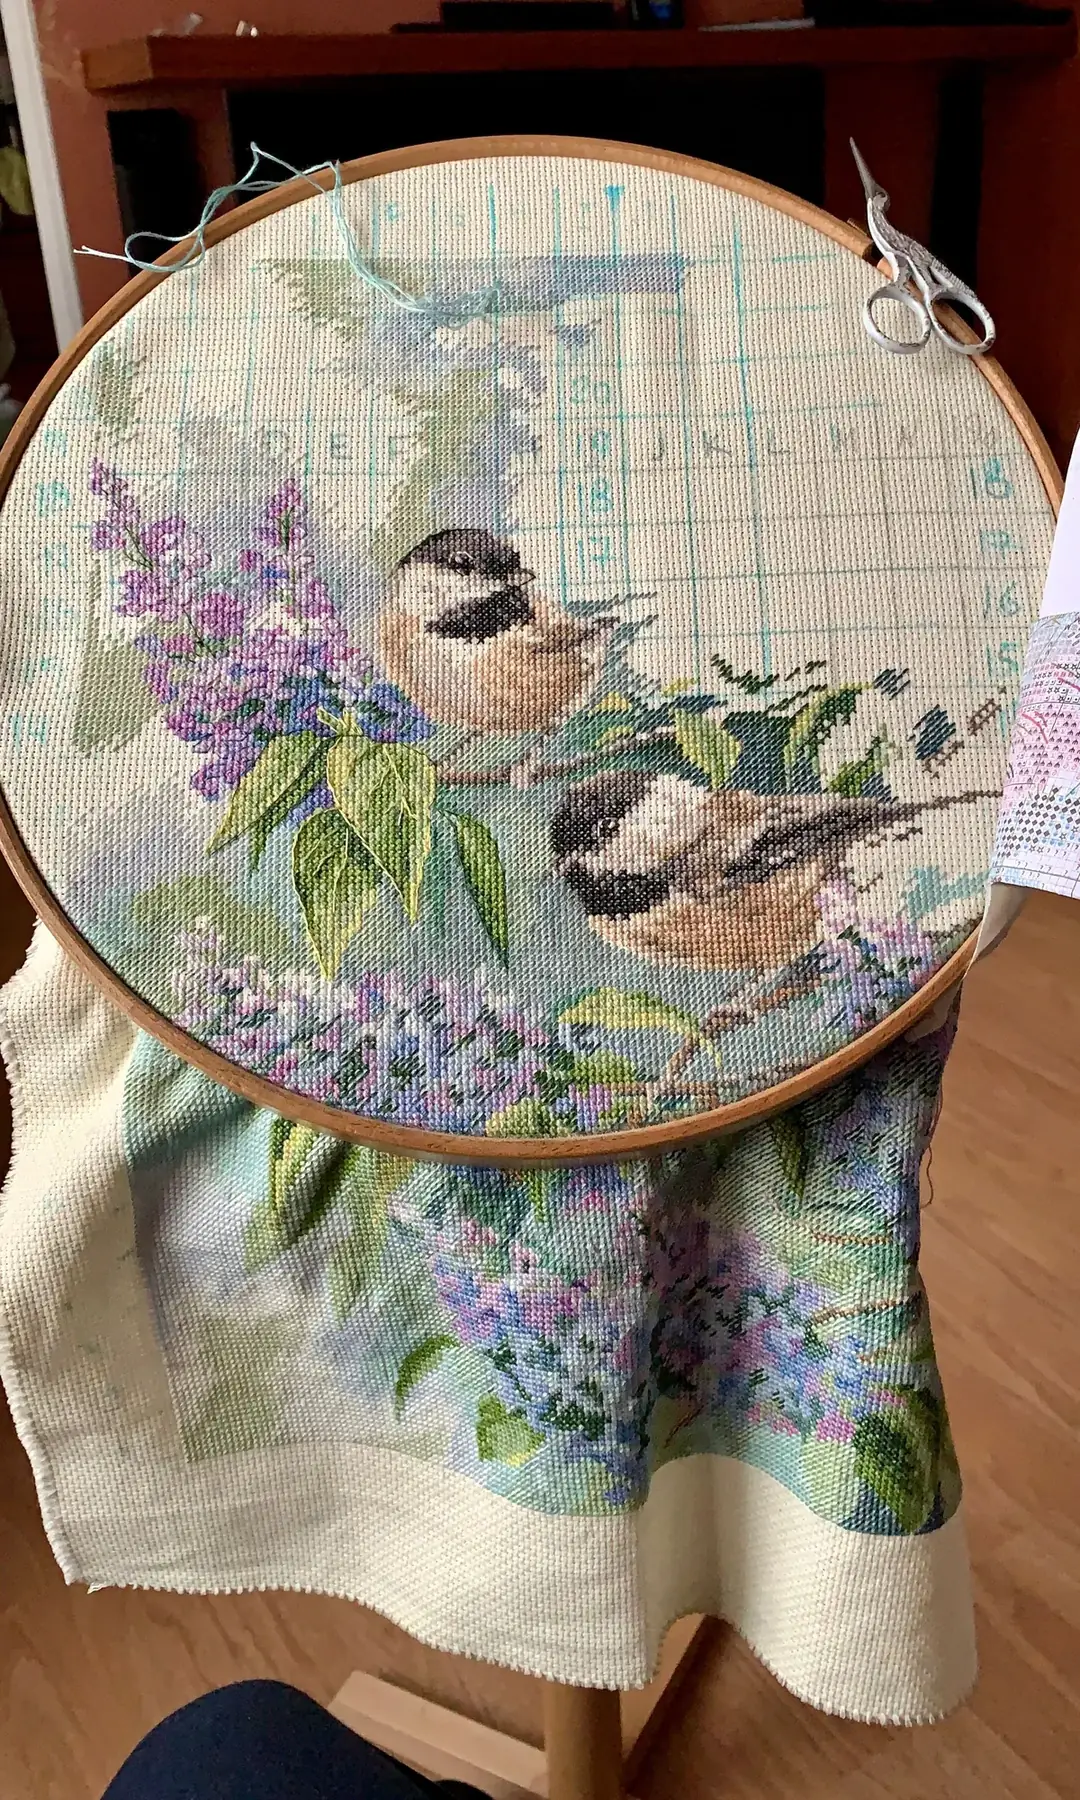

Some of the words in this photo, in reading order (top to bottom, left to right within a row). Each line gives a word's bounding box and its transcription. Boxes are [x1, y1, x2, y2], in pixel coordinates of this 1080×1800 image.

[329, 433, 352, 461] E
[650, 429, 667, 463] J
[702, 429, 733, 458] K
[983, 579, 1021, 619] 16
[985, 640, 1020, 678] 15
